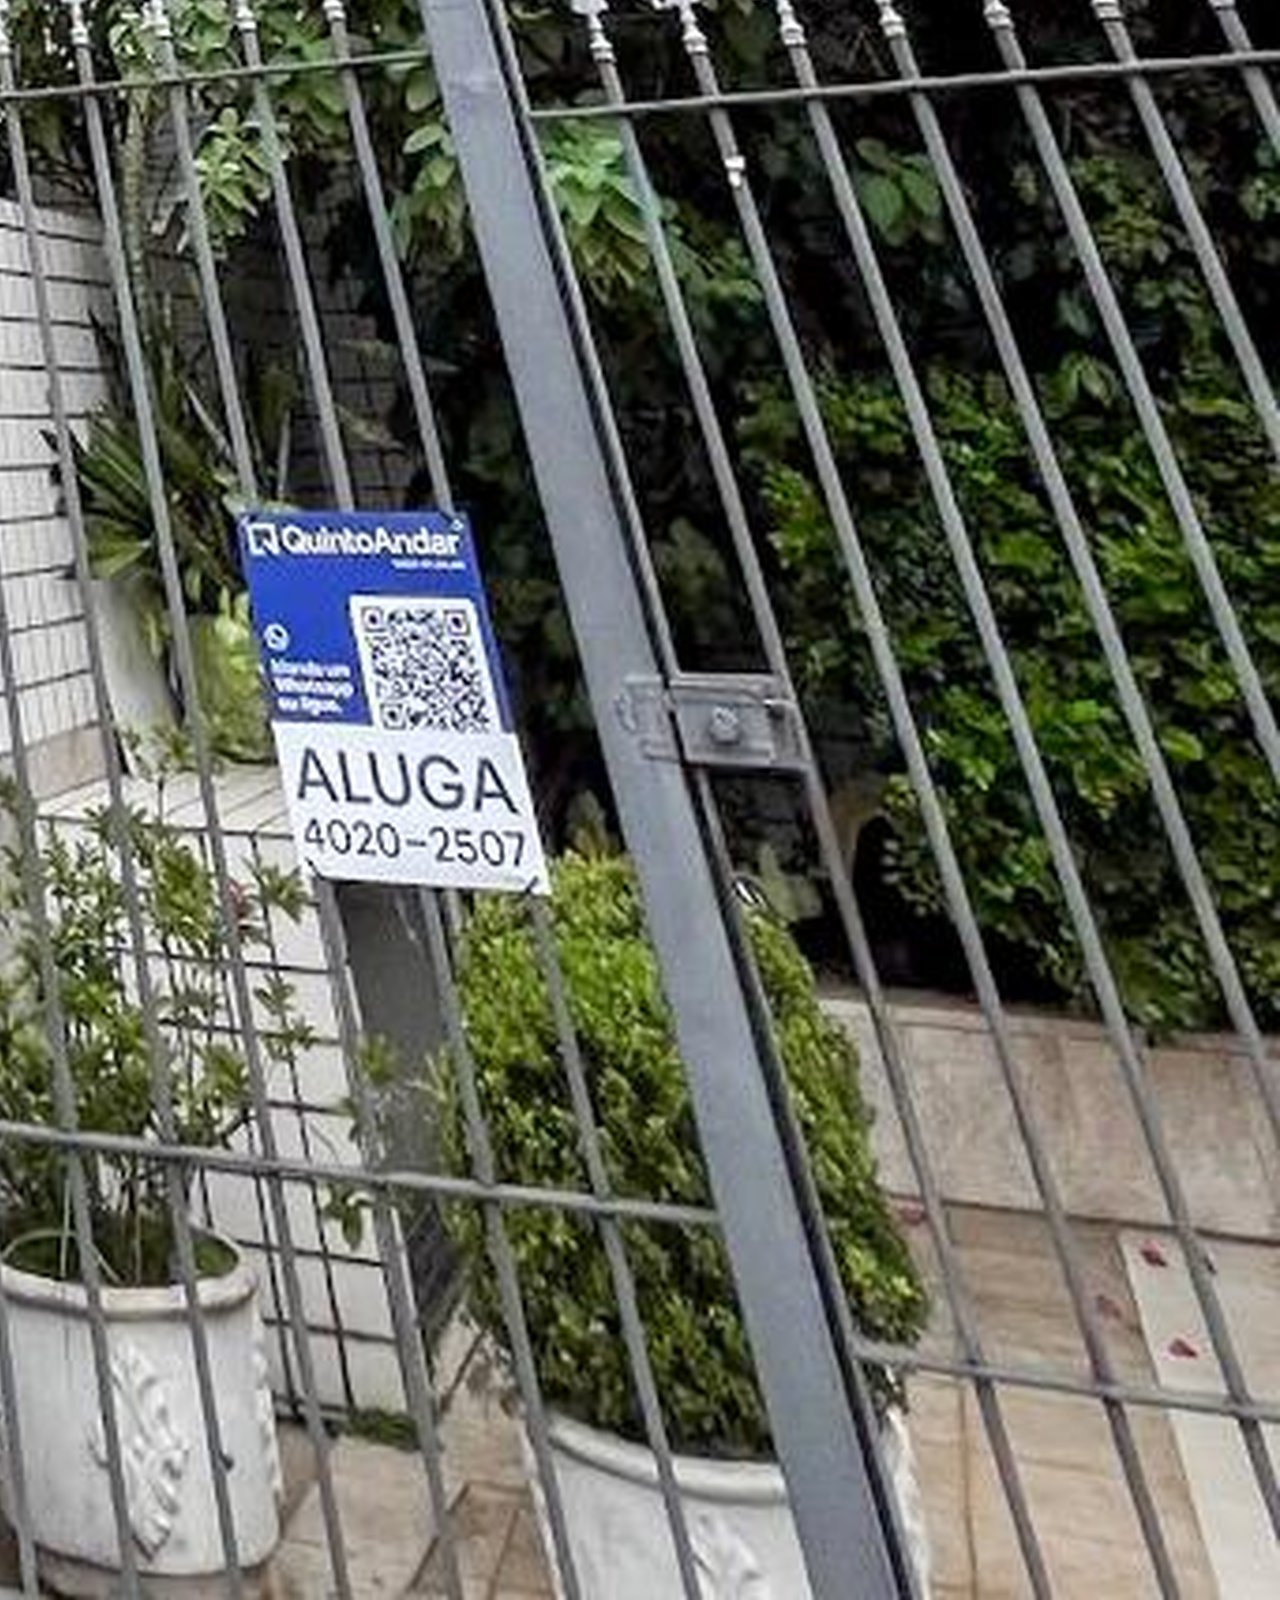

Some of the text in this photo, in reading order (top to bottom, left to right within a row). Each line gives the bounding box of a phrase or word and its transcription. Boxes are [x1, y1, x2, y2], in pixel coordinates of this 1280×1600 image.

[282, 524, 460, 557] QuintoAndar
[296, 746, 518, 815] ALUGA
[303, 818, 526, 867] 4020-2507
